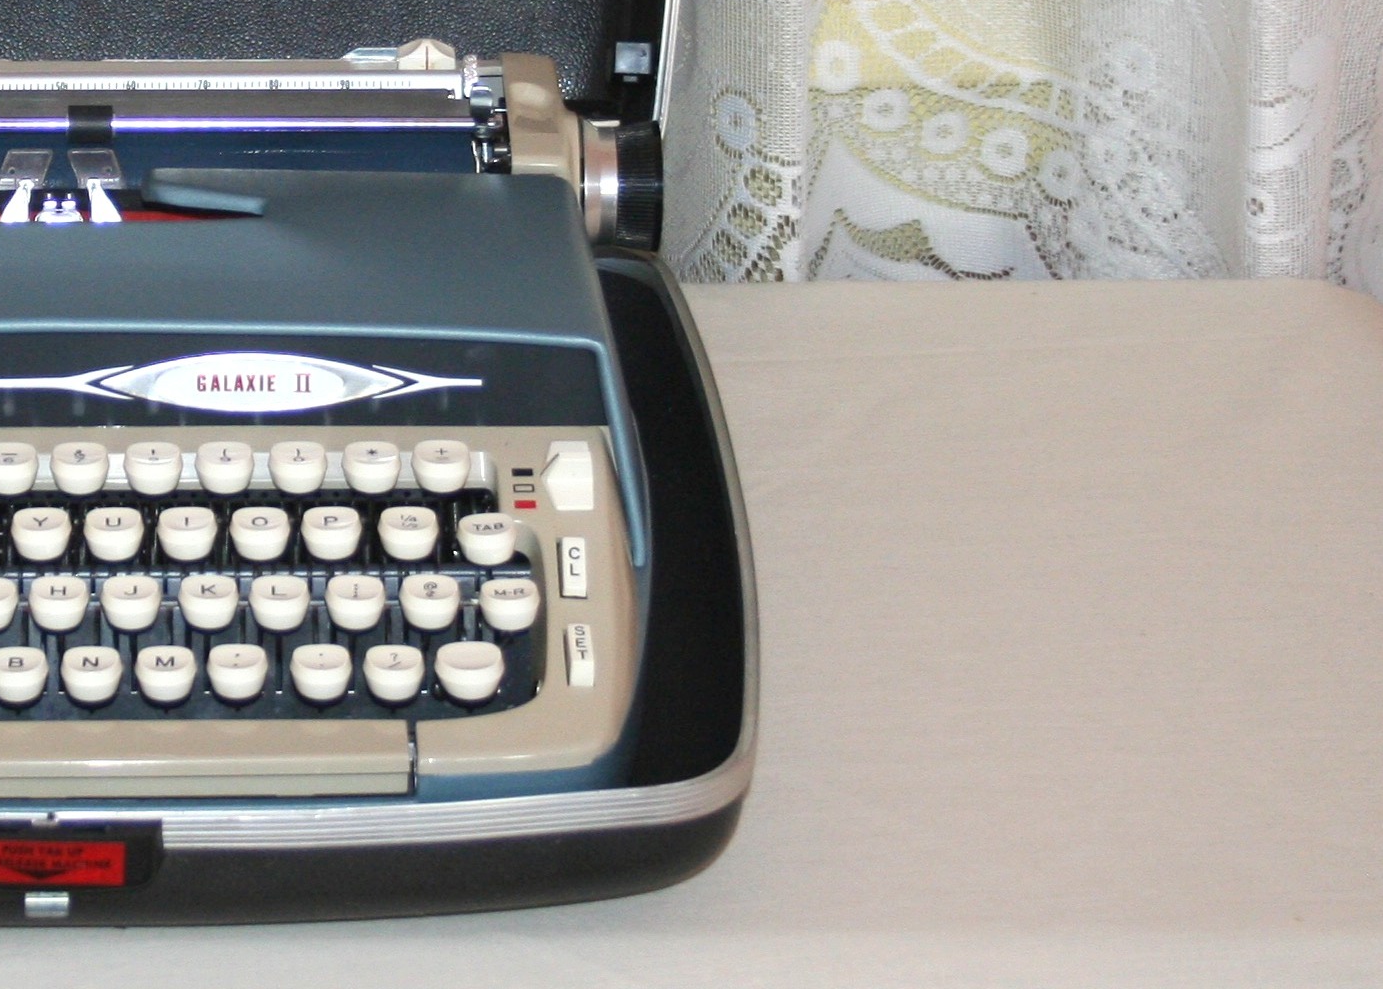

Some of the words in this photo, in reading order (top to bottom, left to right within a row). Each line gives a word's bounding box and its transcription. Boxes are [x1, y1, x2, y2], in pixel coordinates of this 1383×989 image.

[196, 373, 276, 393] GALAXIE
[293, 372, 312, 393] II
[32, 516, 49, 528] Y
[105, 517, 122, 527] U
[323, 516, 338, 527] P
[472, 522, 505, 532] TAB
[50, 586, 67, 597] H
[123, 586, 138, 597] J
[200, 584, 216, 595] K
[271, 586, 286, 597] L
[573, 625, 589, 660] SET
[8, 656, 24, 668] B
[82, 656, 99, 668] N
[155, 656, 175, 668] M
